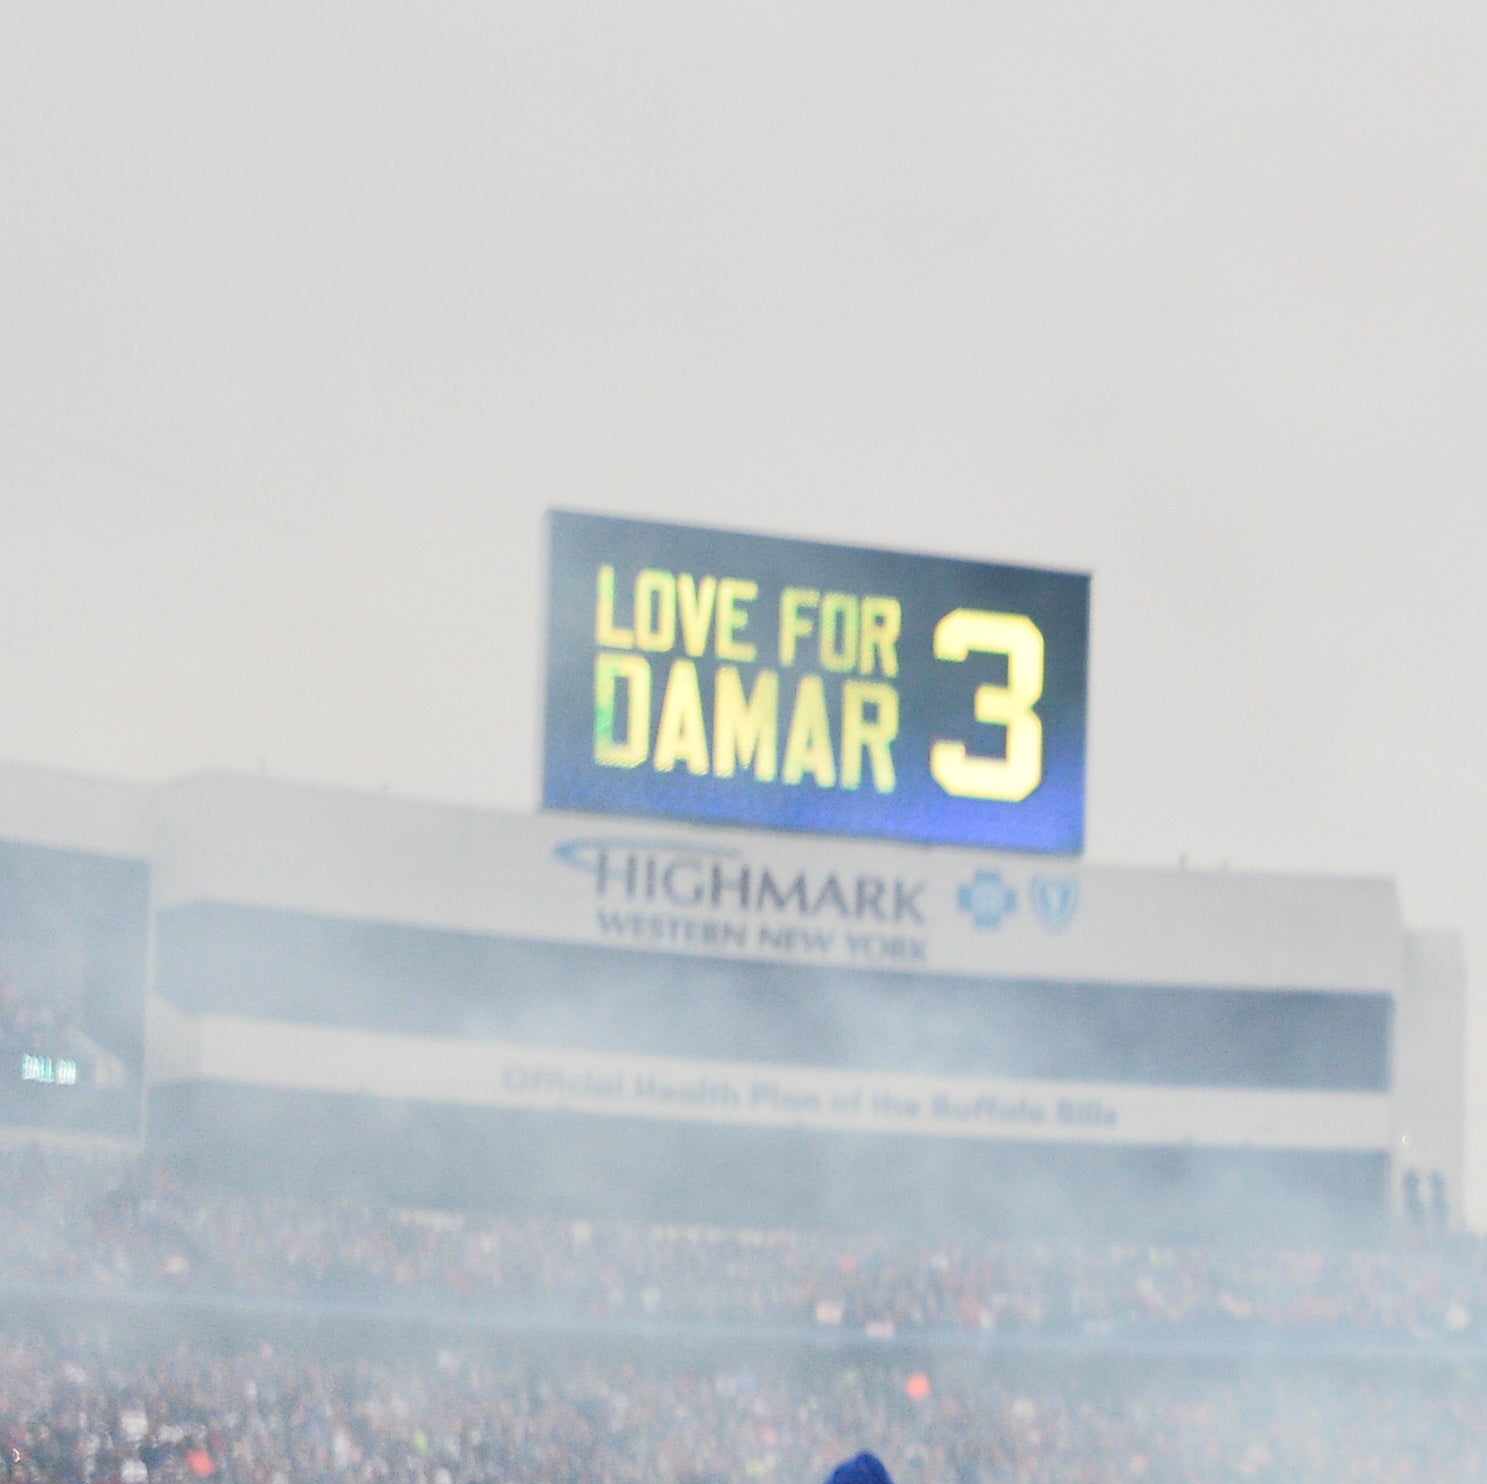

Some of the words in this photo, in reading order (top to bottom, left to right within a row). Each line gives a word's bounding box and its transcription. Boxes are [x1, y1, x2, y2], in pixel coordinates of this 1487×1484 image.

[595, 564, 757, 663] LOVE
[778, 589, 901, 678] FOR
[593, 650, 899, 793] DAMAR
[928, 609, 1045, 802] 3
[596, 850, 926, 926] HIGHMARK
[597, 910, 746, 948] WESTERN
[757, 923, 835, 954] NEW
[844, 932, 926, 961] YORK
